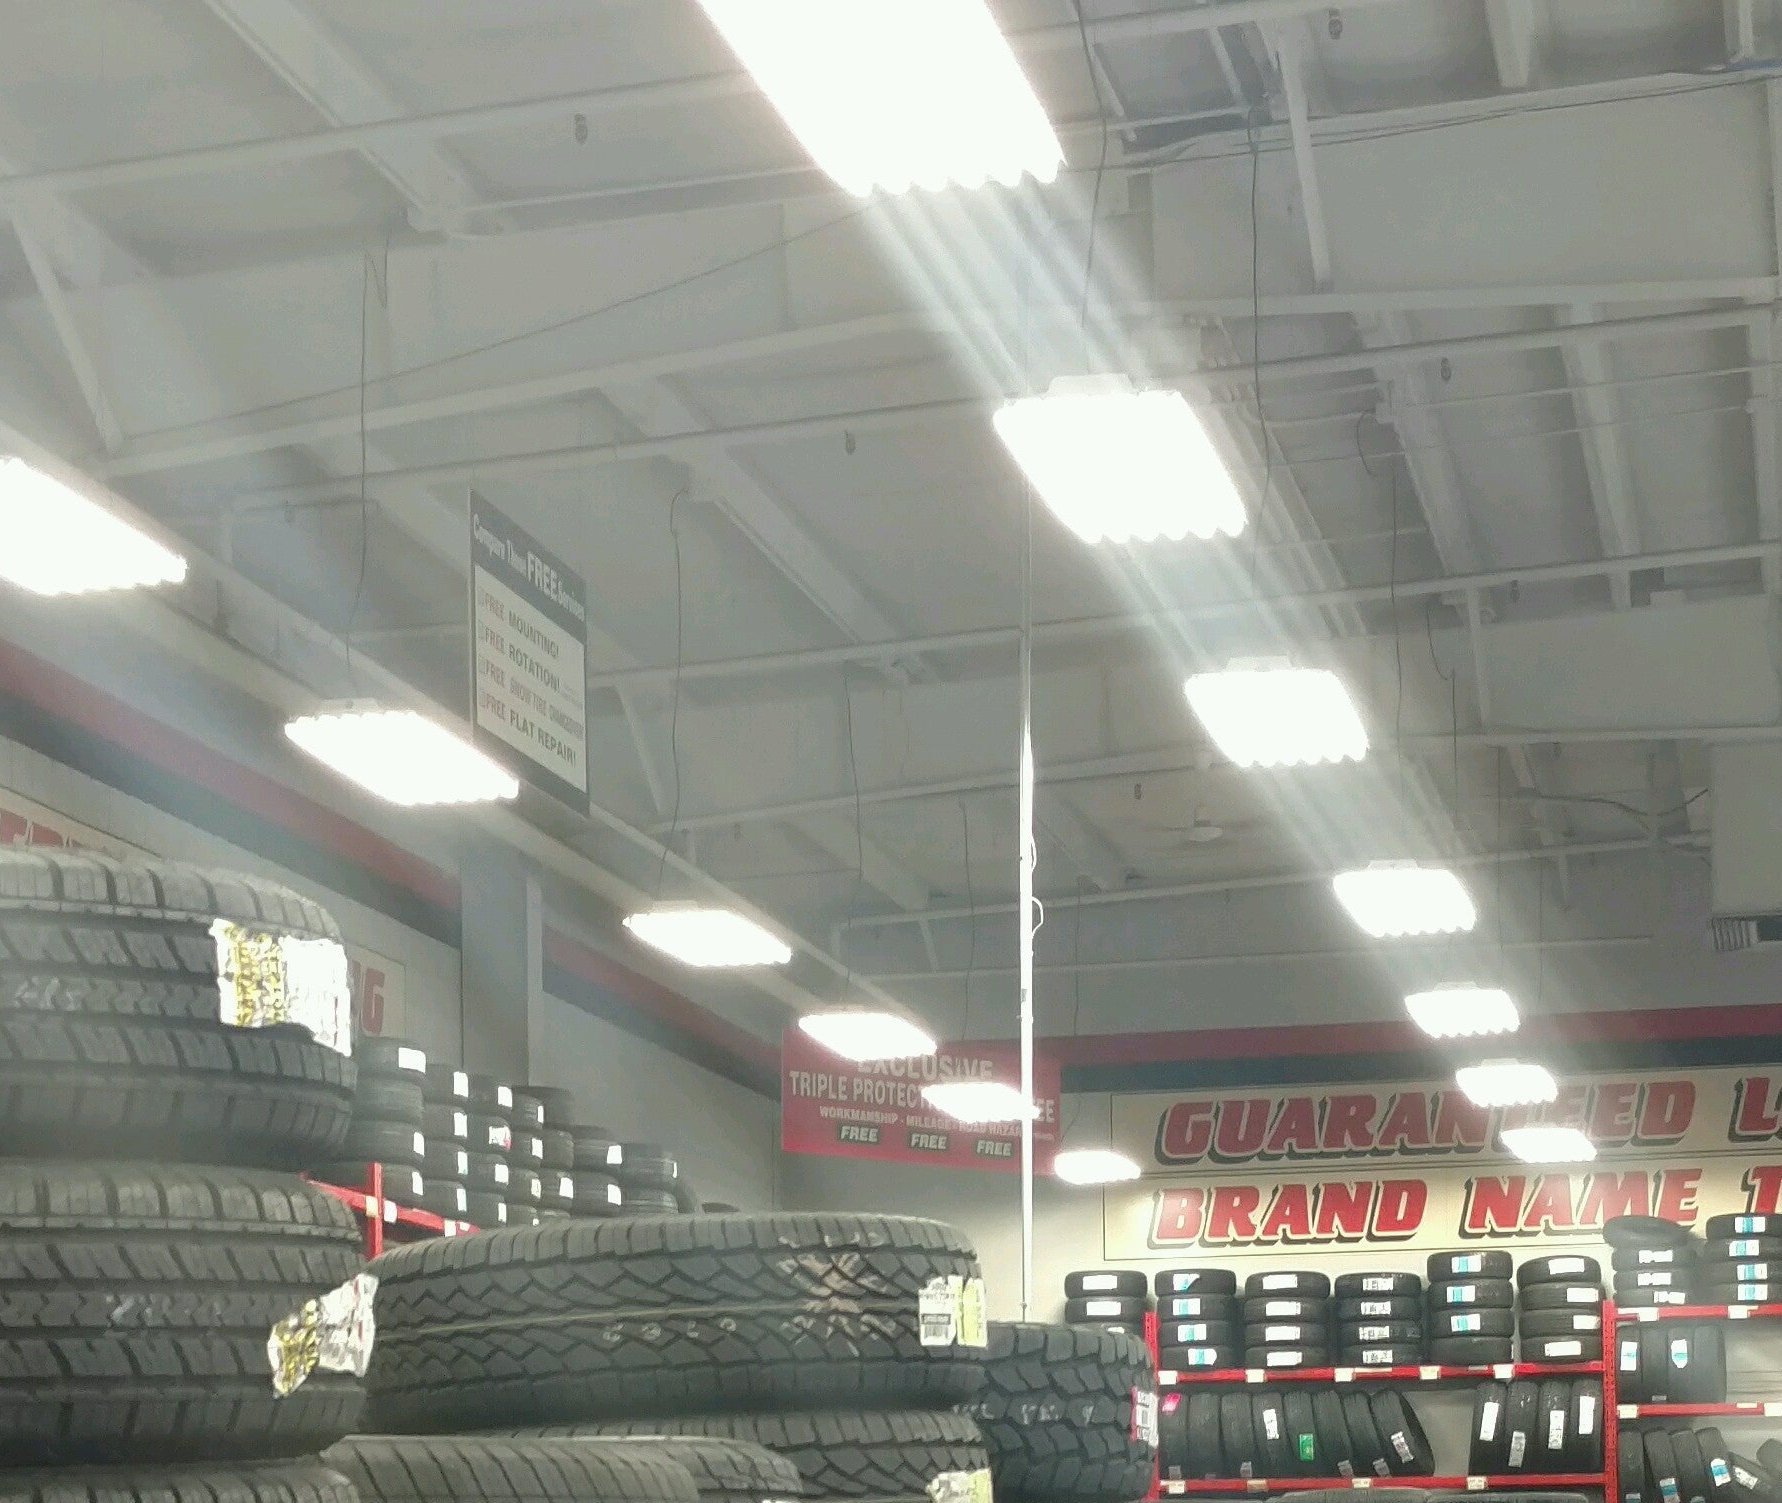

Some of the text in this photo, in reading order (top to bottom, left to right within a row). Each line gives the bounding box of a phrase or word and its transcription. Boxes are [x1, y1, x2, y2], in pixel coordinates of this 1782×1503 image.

[509, 642, 561, 694] ROTATION!
[509, 708, 536, 742] FLAT
[537, 724, 577, 768] REPAIR!
[789, 1070, 848, 1101] TRIPLE
[840, 1125, 1011, 1157] FREE FREE FREE
[1151, 1179, 1429, 1246] BRAND
[1462, 1168, 1702, 1240] NAME
